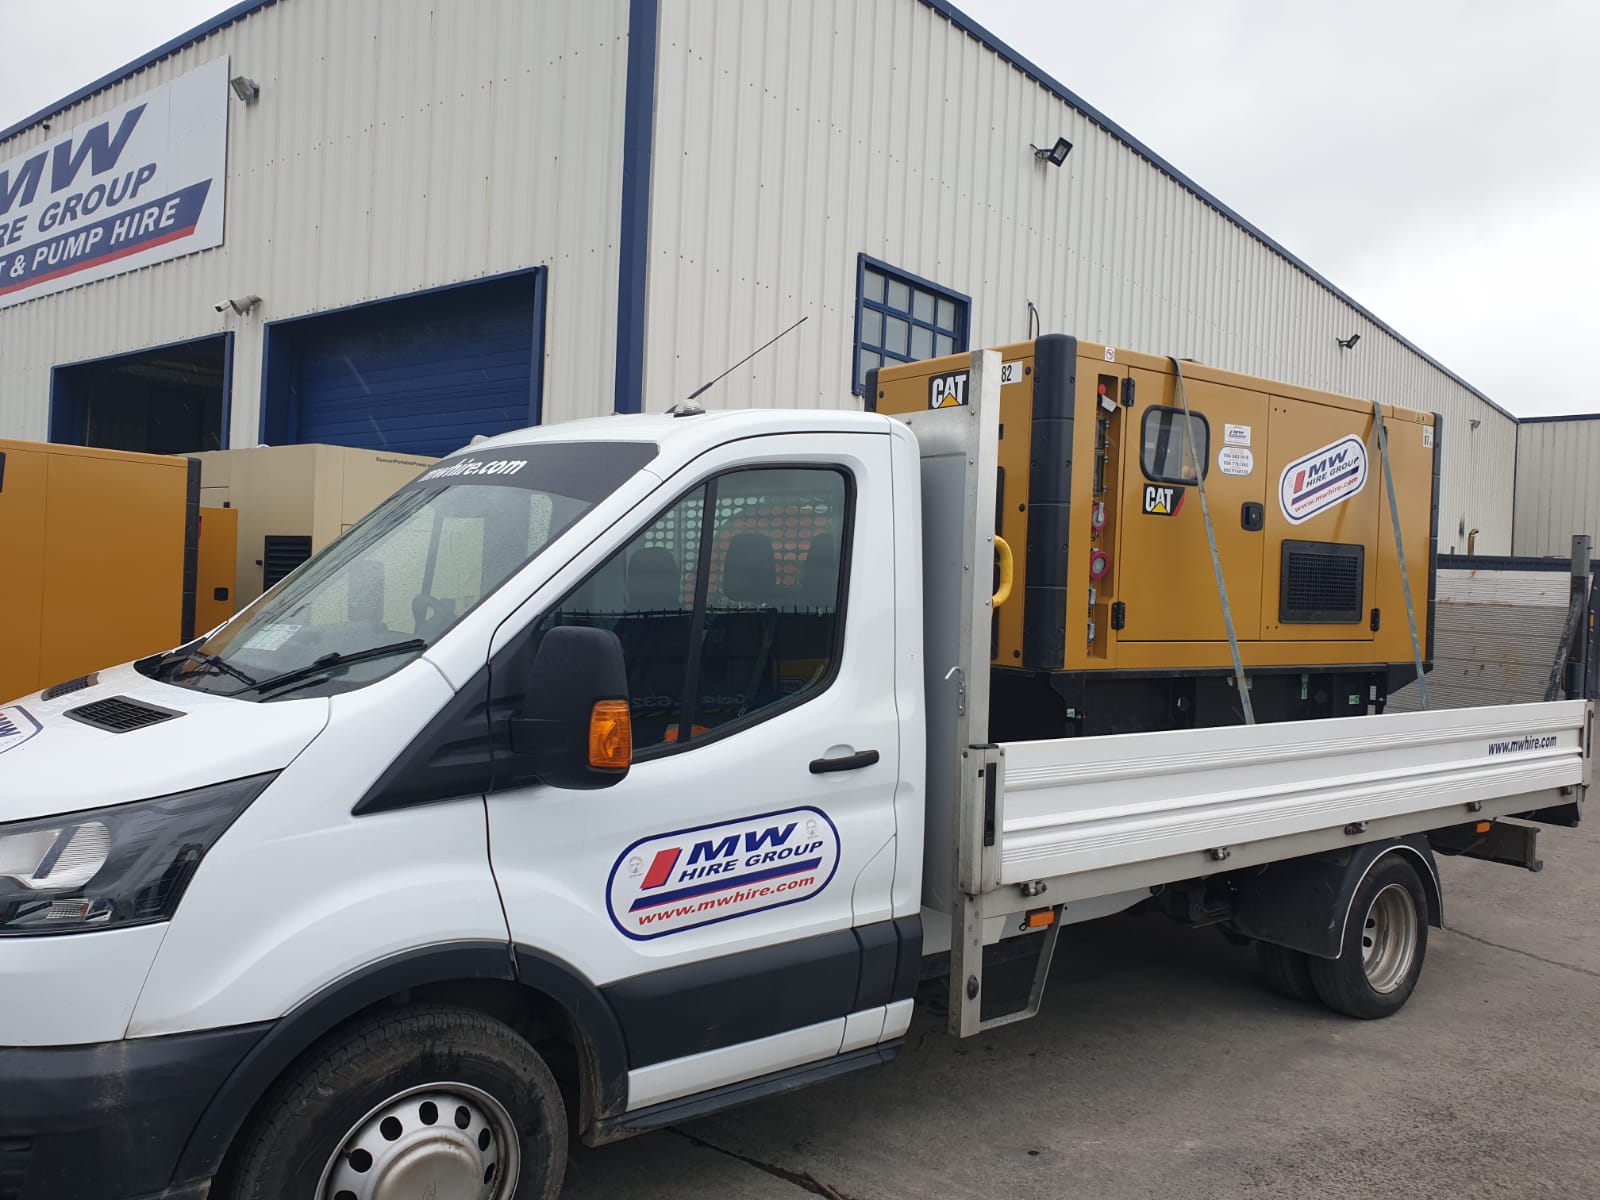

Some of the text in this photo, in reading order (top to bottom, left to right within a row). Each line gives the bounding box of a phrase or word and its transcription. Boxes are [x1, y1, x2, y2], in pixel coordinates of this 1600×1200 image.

[0, 102, 148, 216] MW
[38, 162, 157, 233] GROUP
[10, 197, 181, 278] & PUMP HIRE
[931, 374, 967, 409] CAT
[1306, 456, 1360, 488] HIRE GROUP
[1308, 448, 1349, 478] MW
[1145, 486, 1174, 514] CAT
[1294, 477, 1359, 512] www.mwhire.com
[1488, 735, 1557, 756] www.mwhire.com
[678, 840, 824, 883] HIRE GROUP
[686, 821, 799, 866] MW
[638, 875, 815, 926] www.mwhire.com
